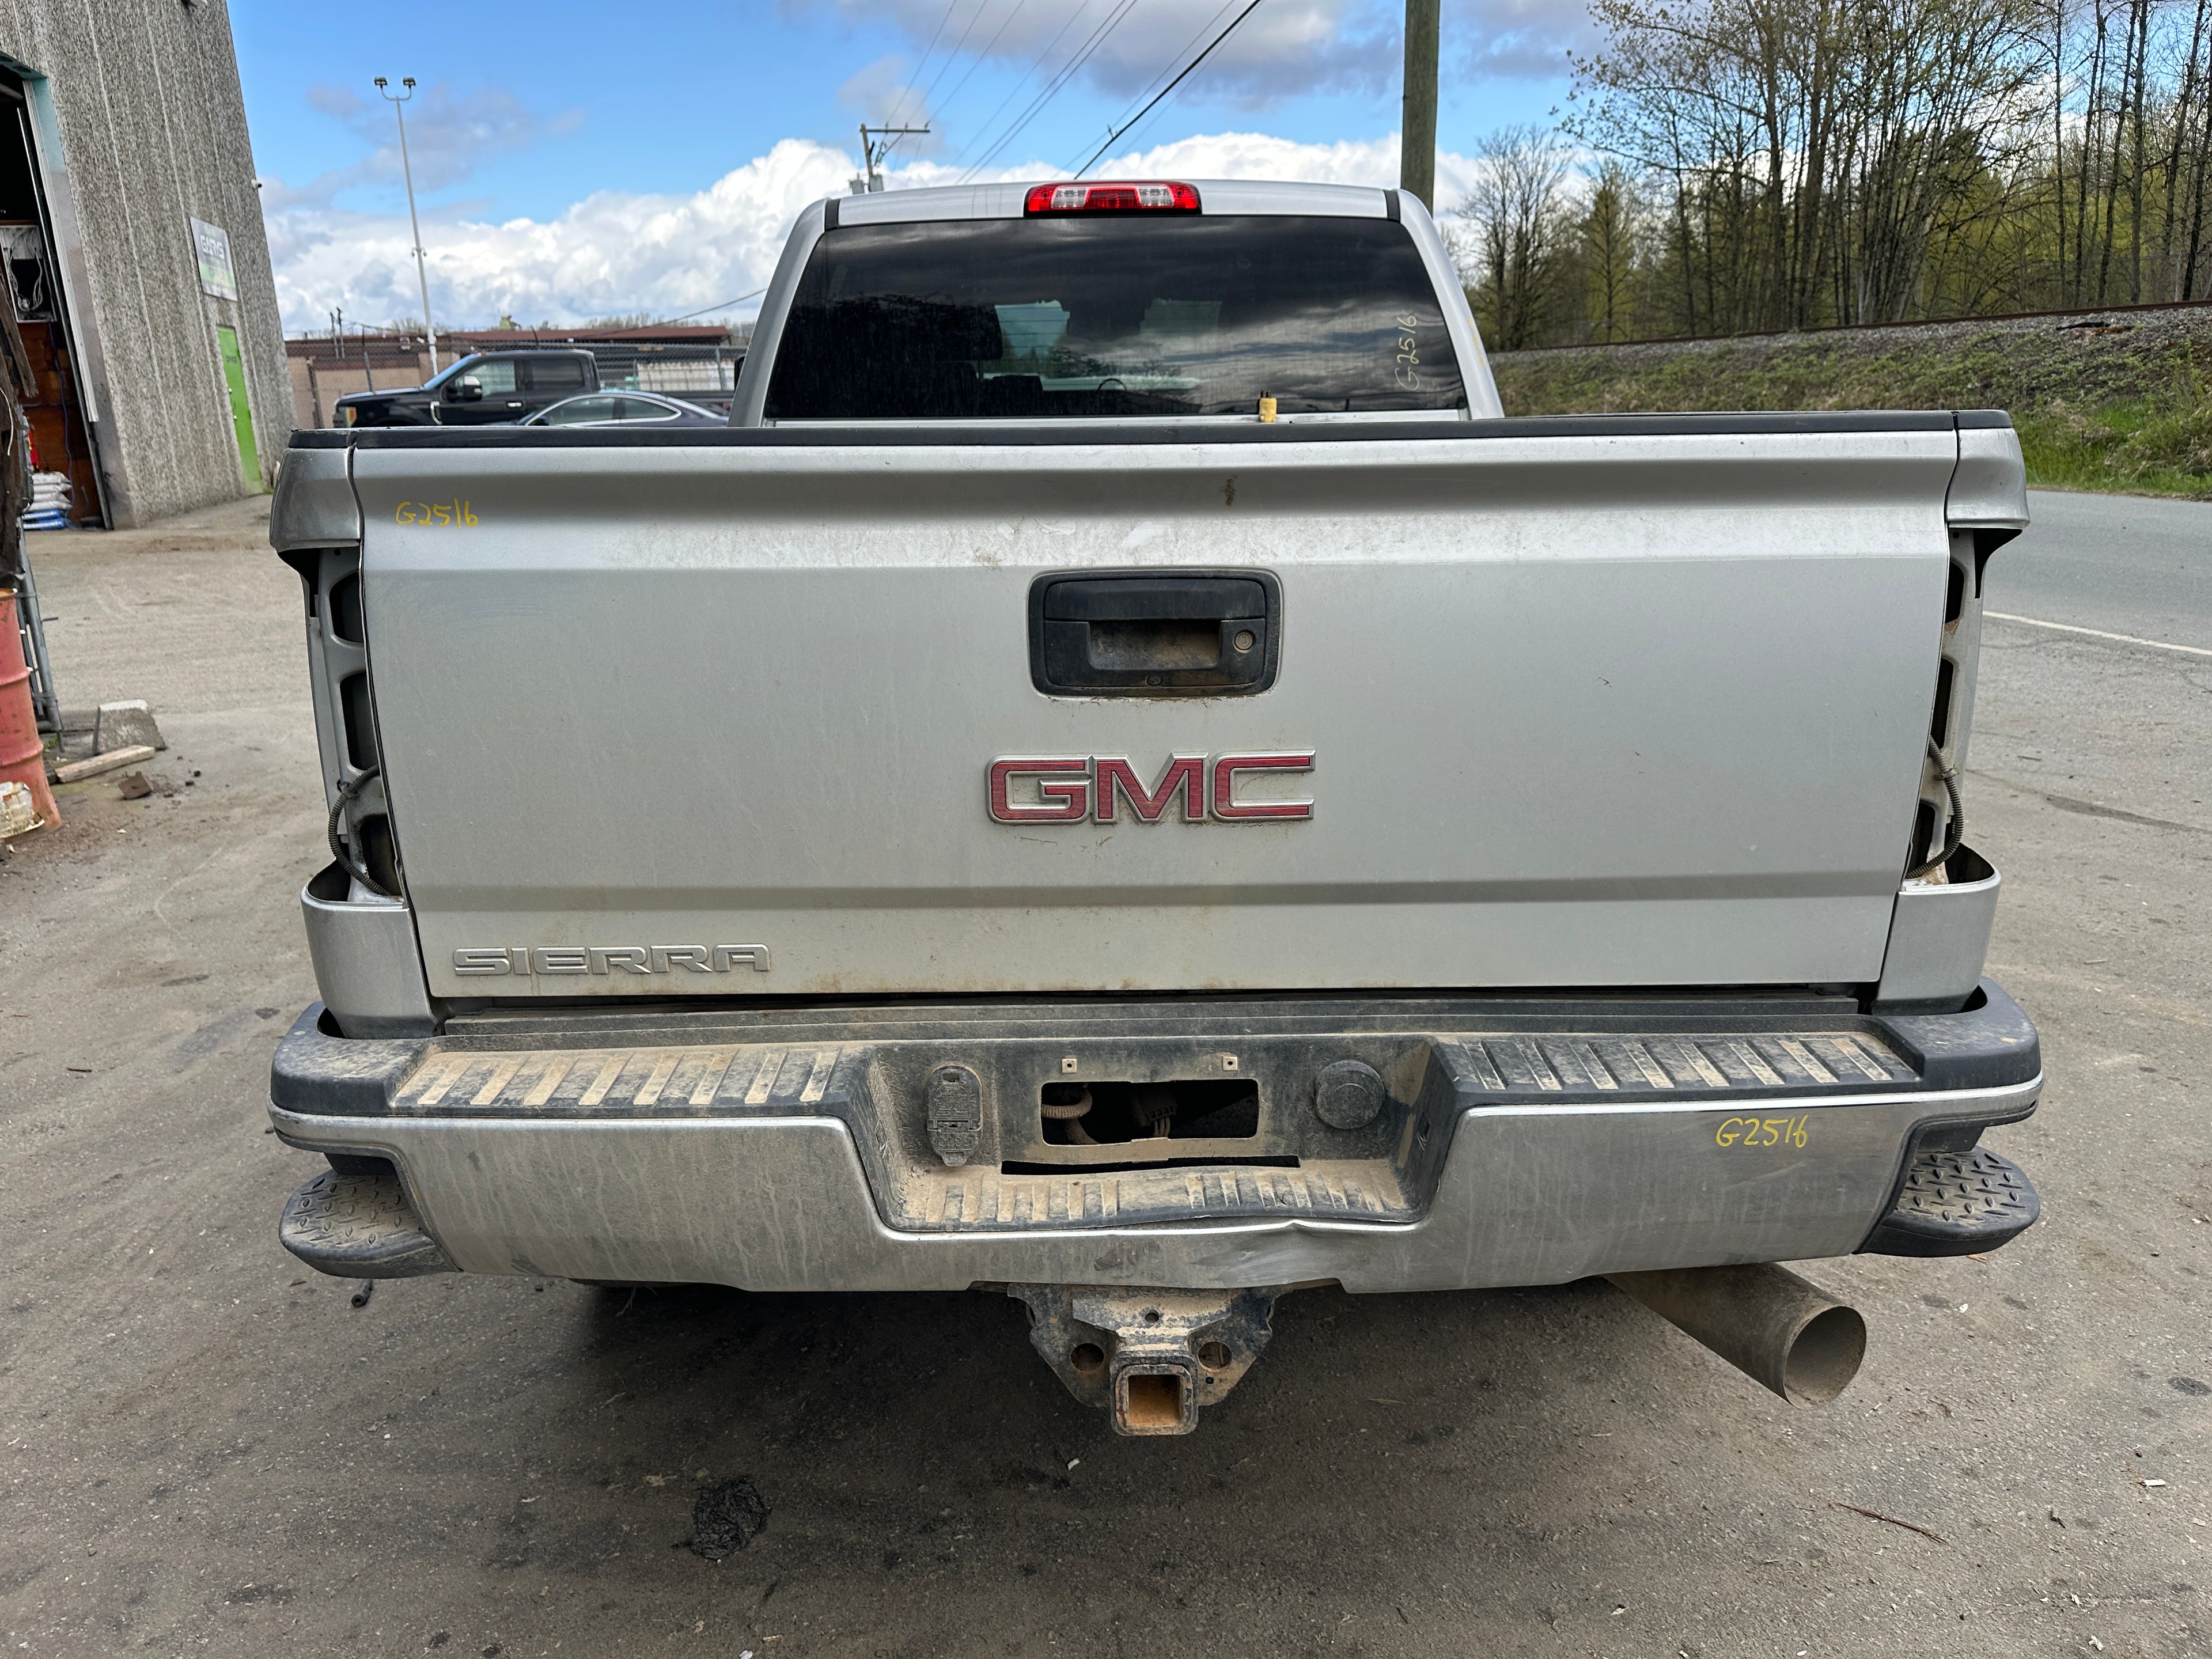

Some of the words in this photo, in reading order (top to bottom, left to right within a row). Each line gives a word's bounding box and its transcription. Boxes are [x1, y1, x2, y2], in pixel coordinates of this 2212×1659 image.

[1395, 315, 1419, 391] G2516
[395, 498, 479, 529] G2516
[985, 750, 1316, 825] GMC
[453, 943, 771, 976] SIERRA
[1715, 1114, 1809, 1149] G2516
